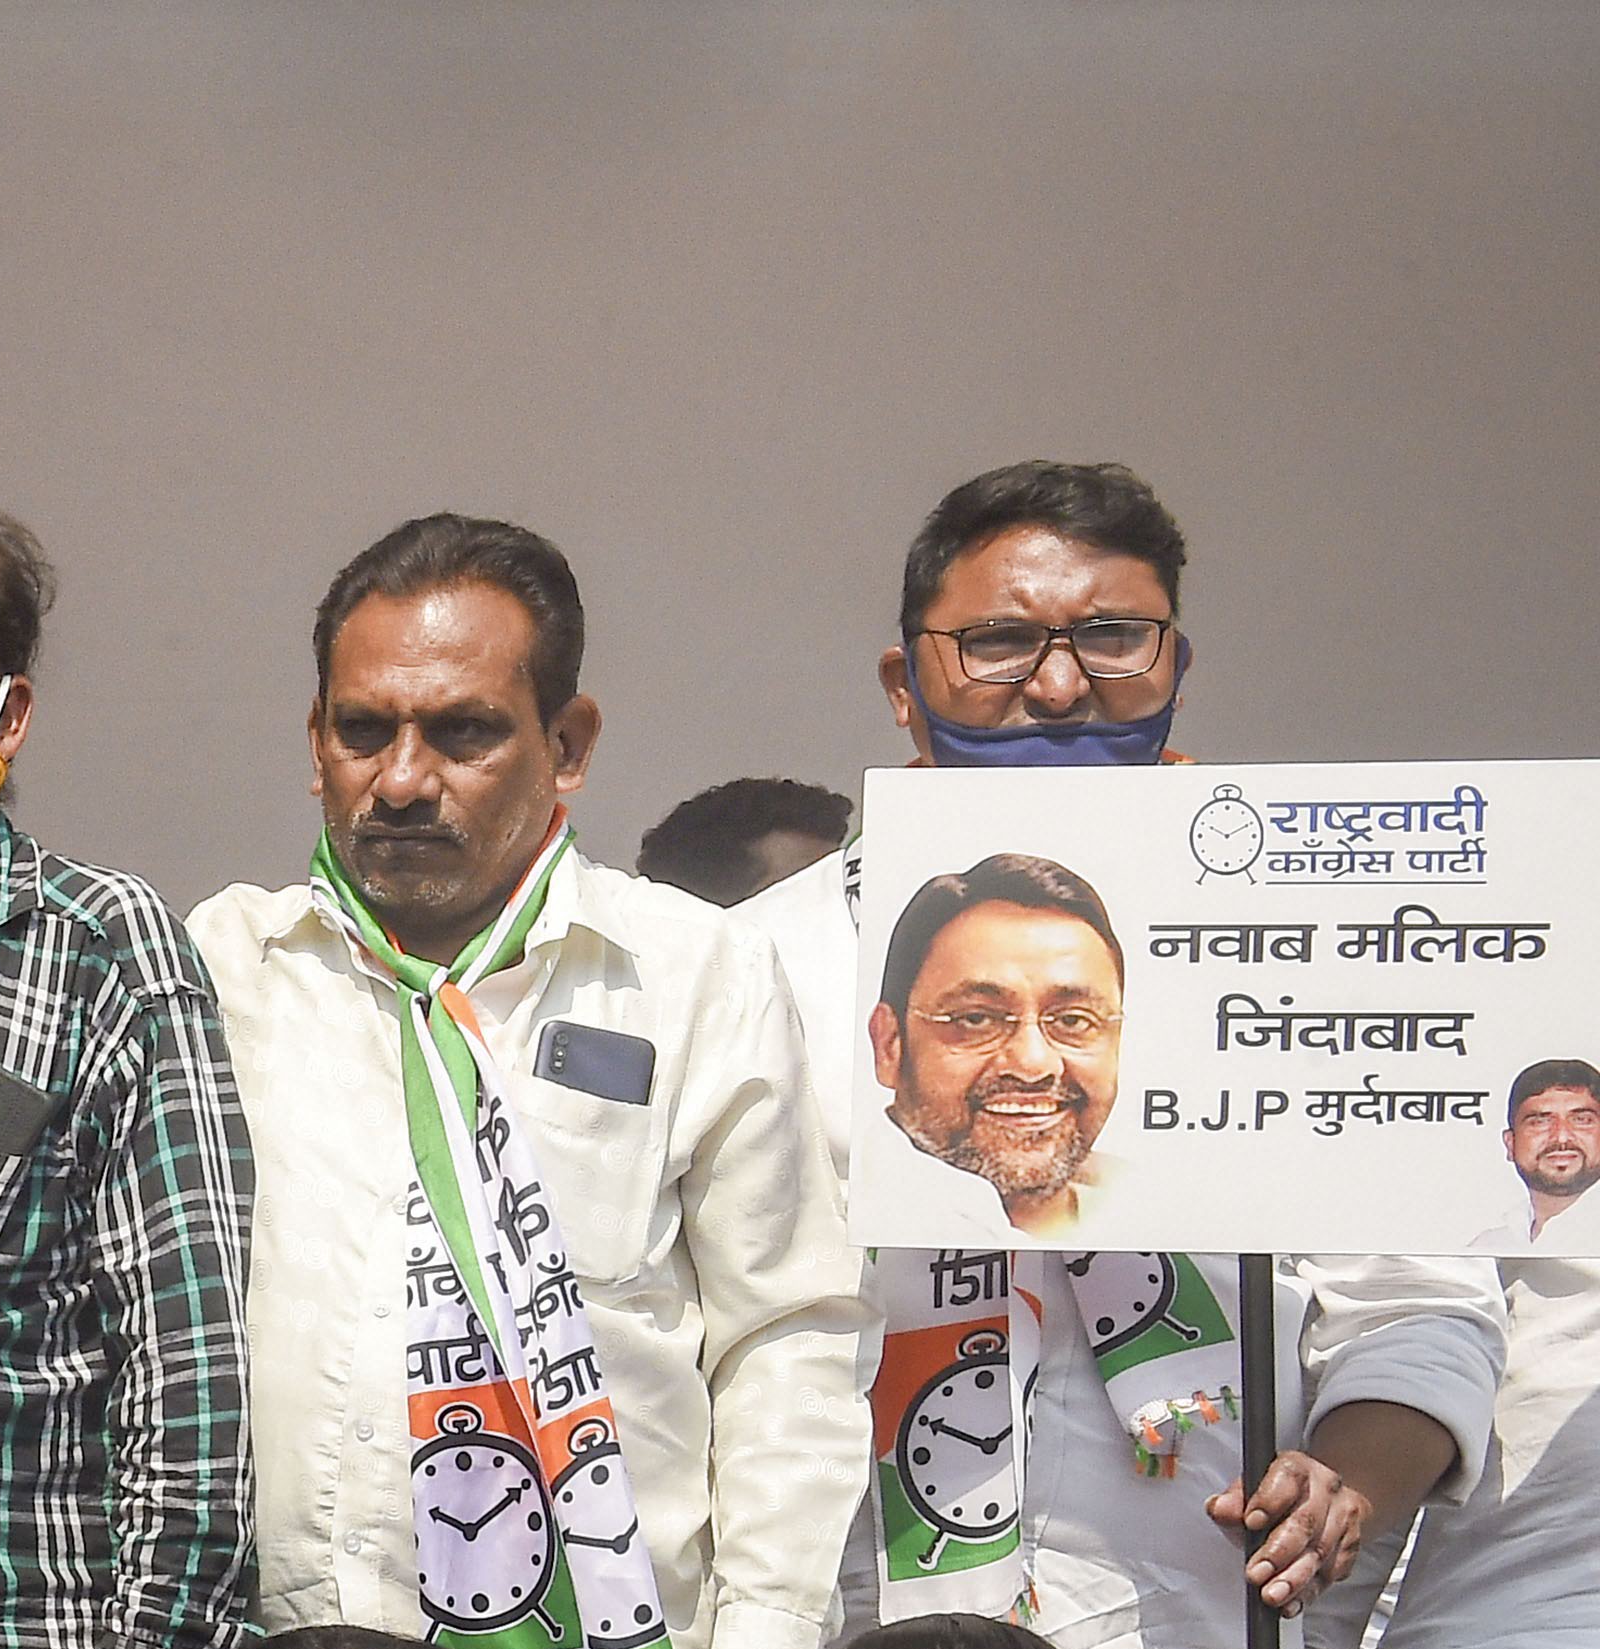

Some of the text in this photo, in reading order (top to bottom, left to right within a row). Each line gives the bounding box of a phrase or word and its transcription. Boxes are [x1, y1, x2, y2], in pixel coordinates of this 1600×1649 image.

[1406, 837, 1487, 872] पार्टी
[1149, 905, 1550, 963] नवाब मलिक
[1216, 994, 1474, 1055] जिंदाबाद
[1144, 1074, 1489, 1136] B.J.P मुर्दाबाद
